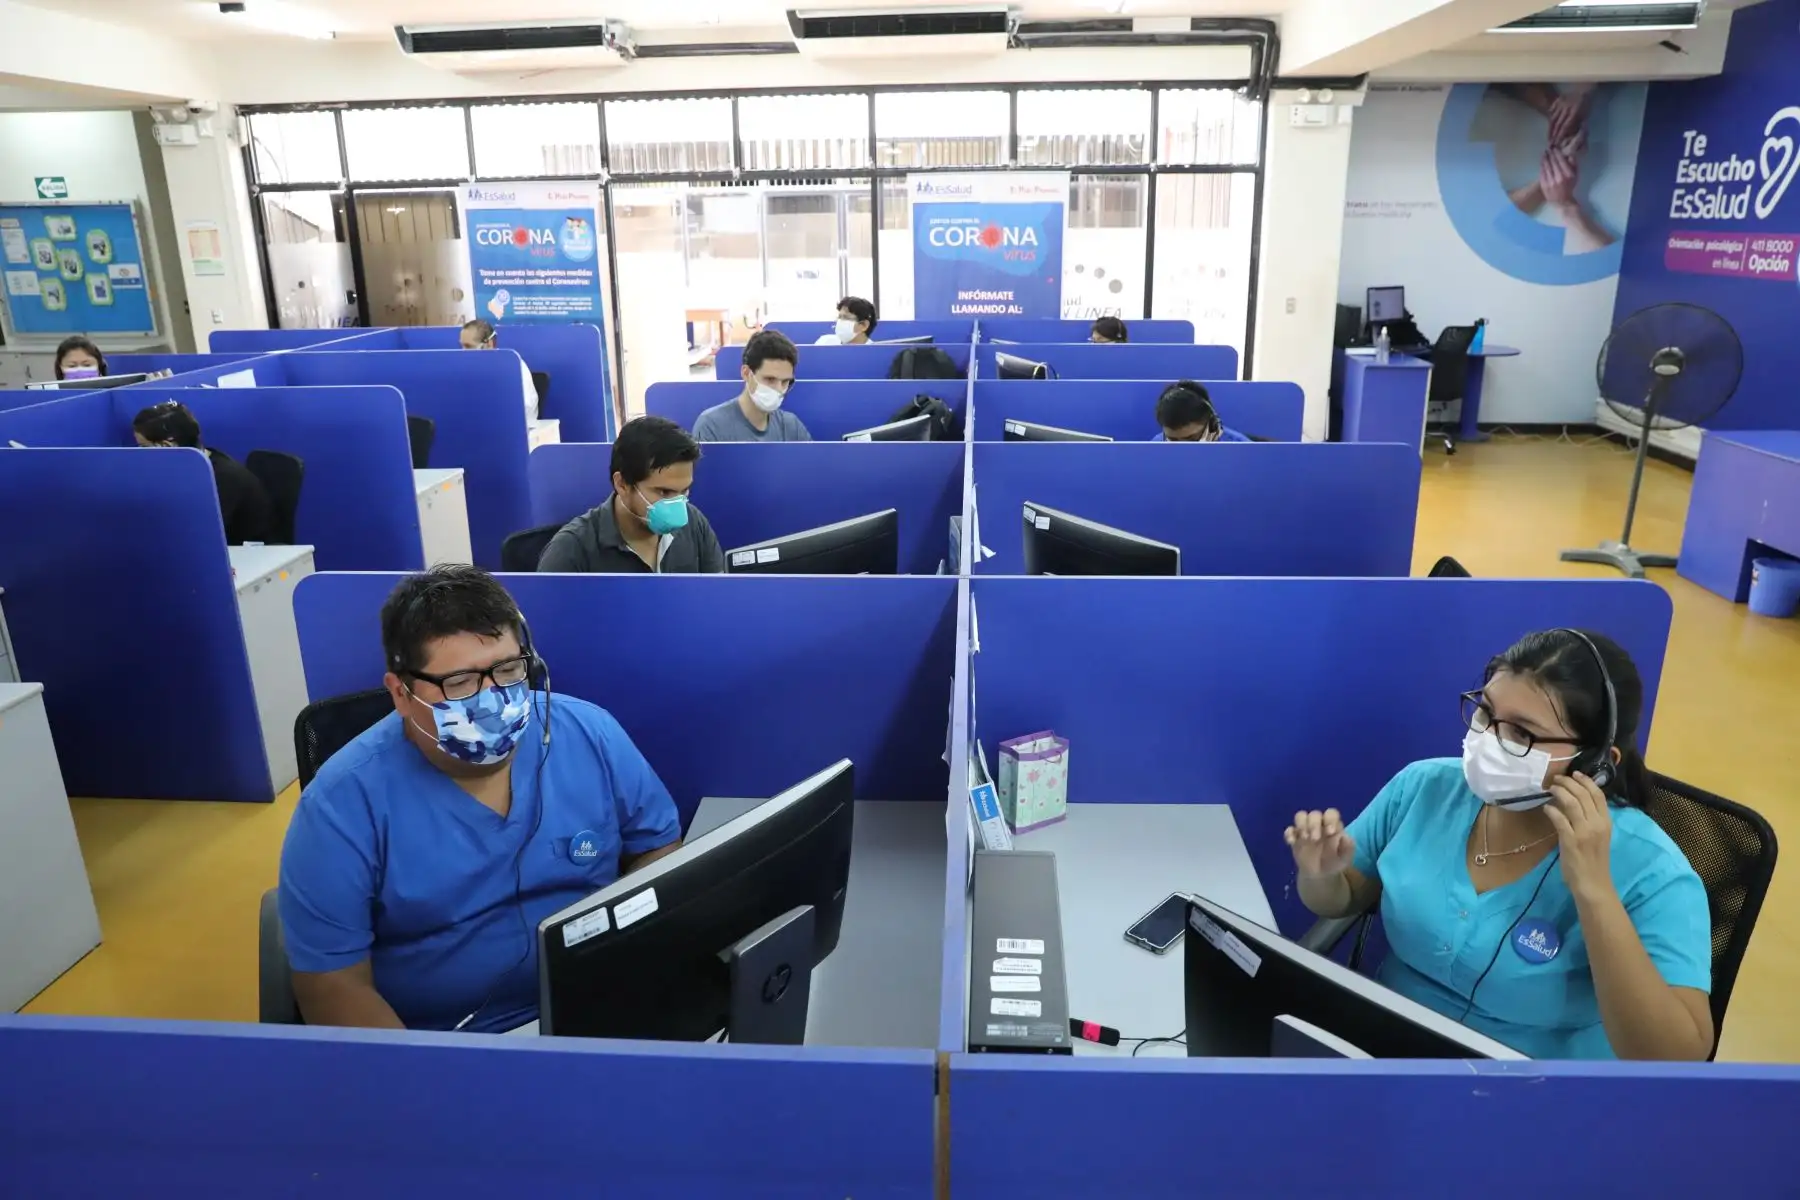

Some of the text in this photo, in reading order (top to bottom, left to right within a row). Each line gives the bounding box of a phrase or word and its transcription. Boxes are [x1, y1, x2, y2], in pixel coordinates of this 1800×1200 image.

[1683, 130, 1708, 157] Te
[1676, 154, 1755, 184] Escucho
[1669, 184, 1752, 219] EsSalud
[476, 227, 556, 246] CORONA
[929, 225, 1038, 248] CORONA
[1004, 248, 1036, 261] virus
[1748, 254, 1790, 274] Opción
[958, 289, 1014, 301] INFÓRMATE
[951, 304, 1006, 314] LLAMANDO
[1518, 934, 1553, 958] EsSalud
